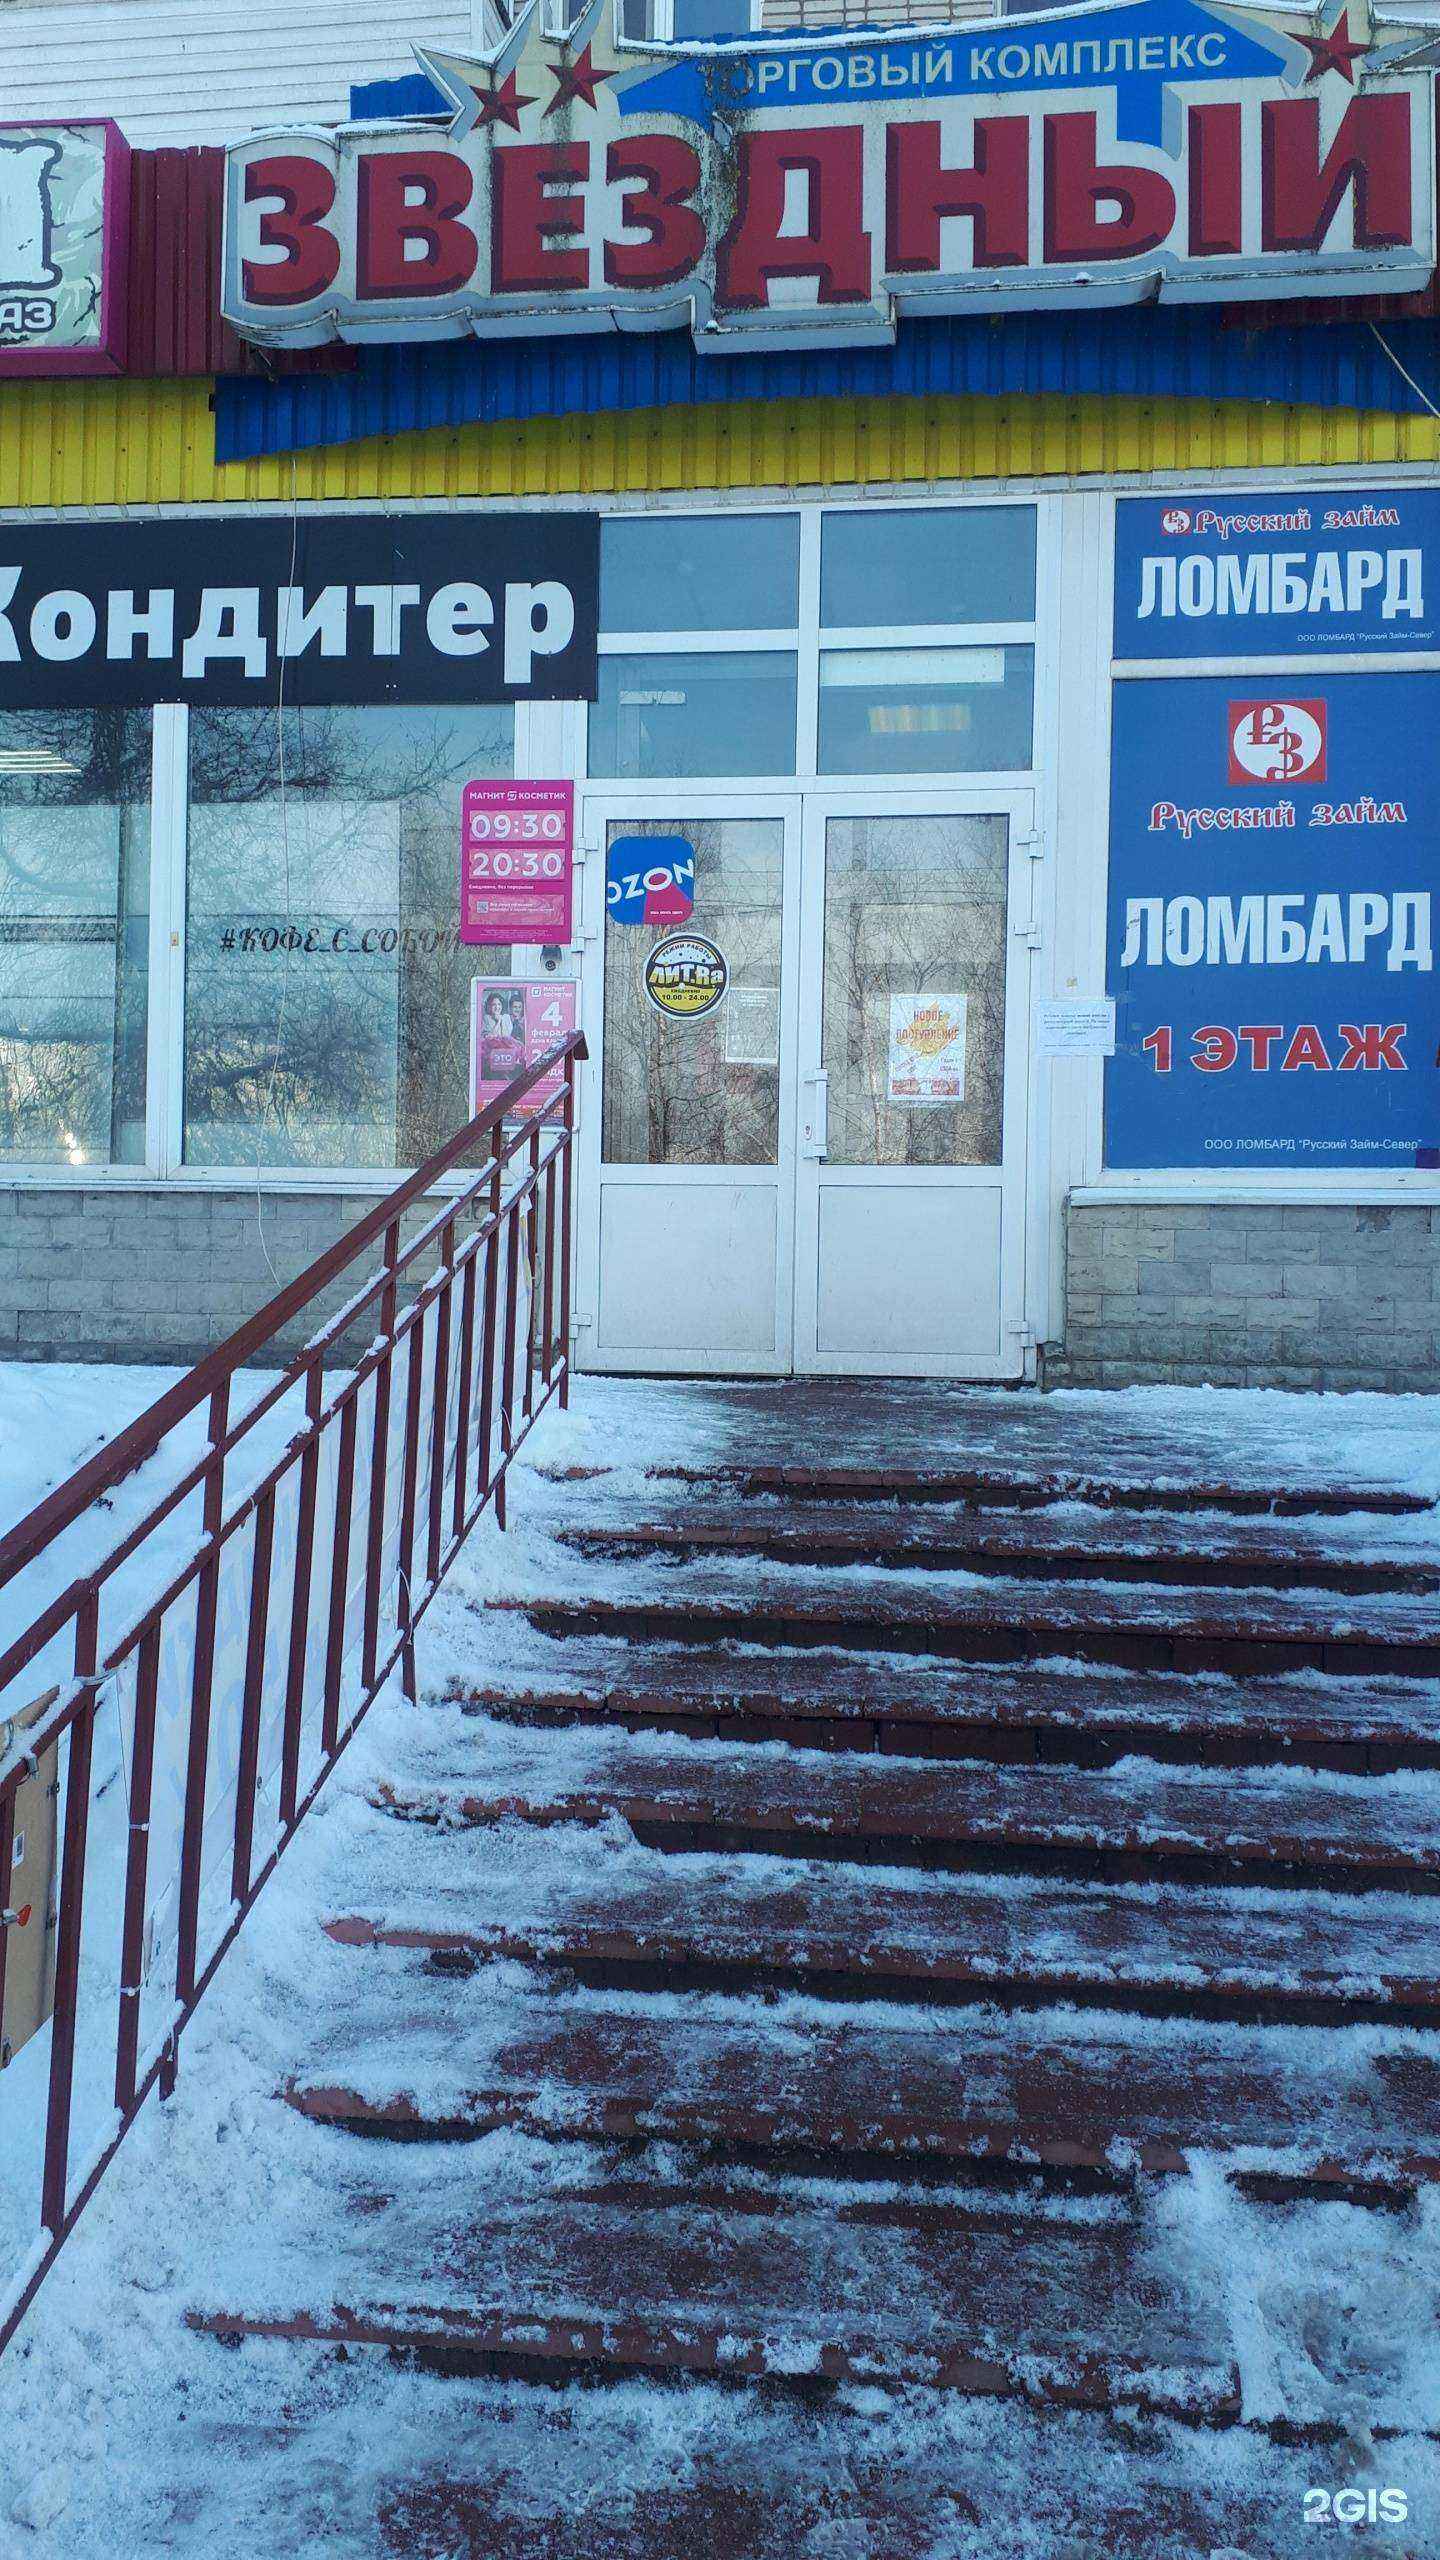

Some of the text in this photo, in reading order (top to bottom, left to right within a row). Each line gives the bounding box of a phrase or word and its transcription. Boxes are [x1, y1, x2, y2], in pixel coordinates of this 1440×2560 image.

[969, 32, 1228, 81] КОМПЛЕКС
[1194, 504, 1311, 539] Русский
[1137, 548, 1424, 618] ЛОМБАРД
[1297, 633, 1316, 642] ООО
[1317, 632, 1355, 642] ЛОМБАРД
[469, 791, 567, 800] МАГНИТ КОСМЕТИК
[471, 813, 562, 839] 09:30
[1148, 801, 1296, 839] Русский
[472, 852, 562, 877] 20:30
[1120, 892, 1433, 972] ЛОМБАРД
[541, 1001, 563, 1027] 4
[1142, 1024, 1408, 1072] 1 ЭТАЖ
[1204, 1138, 1232, 1150] ООО
[1235, 1138, 1296, 1152] ЛОМБАРД
[1299, 1138, 1347, 1150] "Русский
